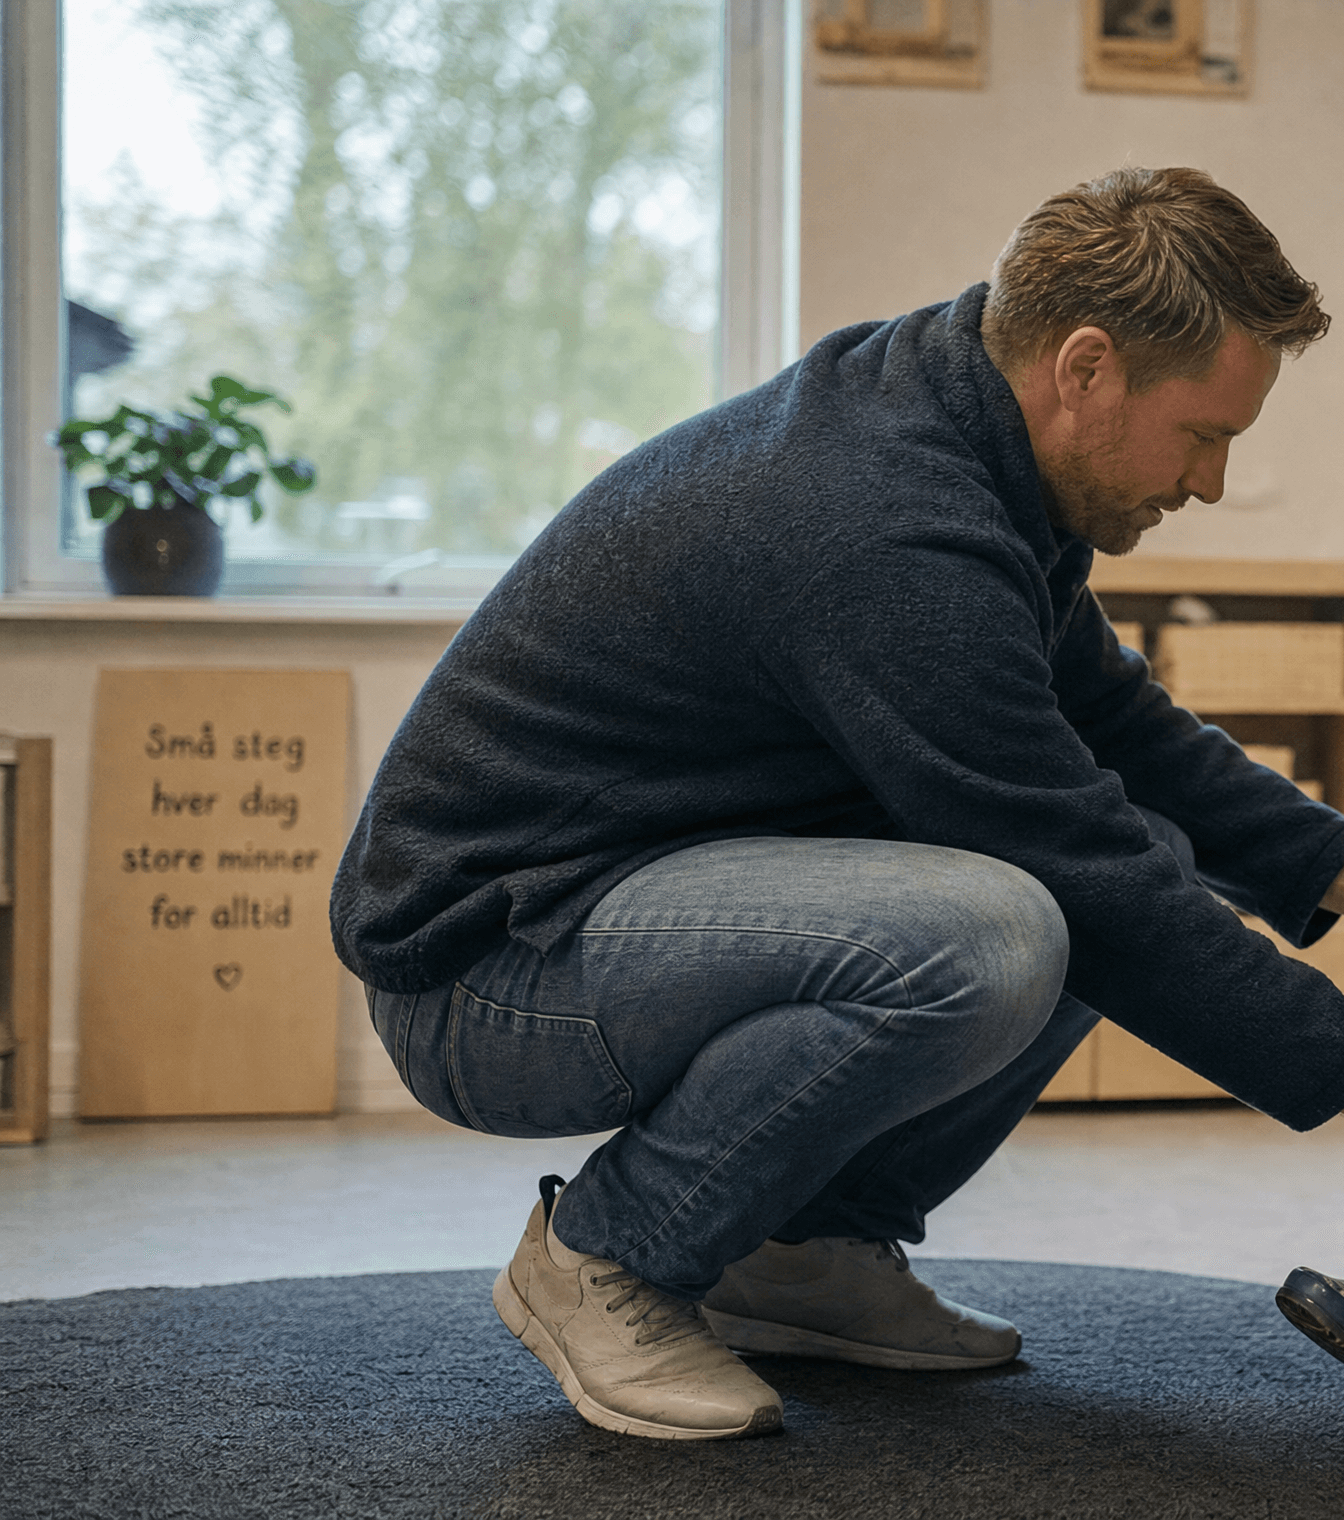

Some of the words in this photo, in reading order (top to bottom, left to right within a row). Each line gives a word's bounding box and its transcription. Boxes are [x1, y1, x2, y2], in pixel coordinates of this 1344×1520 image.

[146, 723, 215, 760] Små
[232, 731, 306, 773] steg
[152, 778, 219, 817] hver
[240, 780, 299, 831] dag
[122, 844, 204, 873] store
[218, 841, 320, 873] minner
[151, 893, 196, 930] for
[211, 893, 292, 930] alltid
